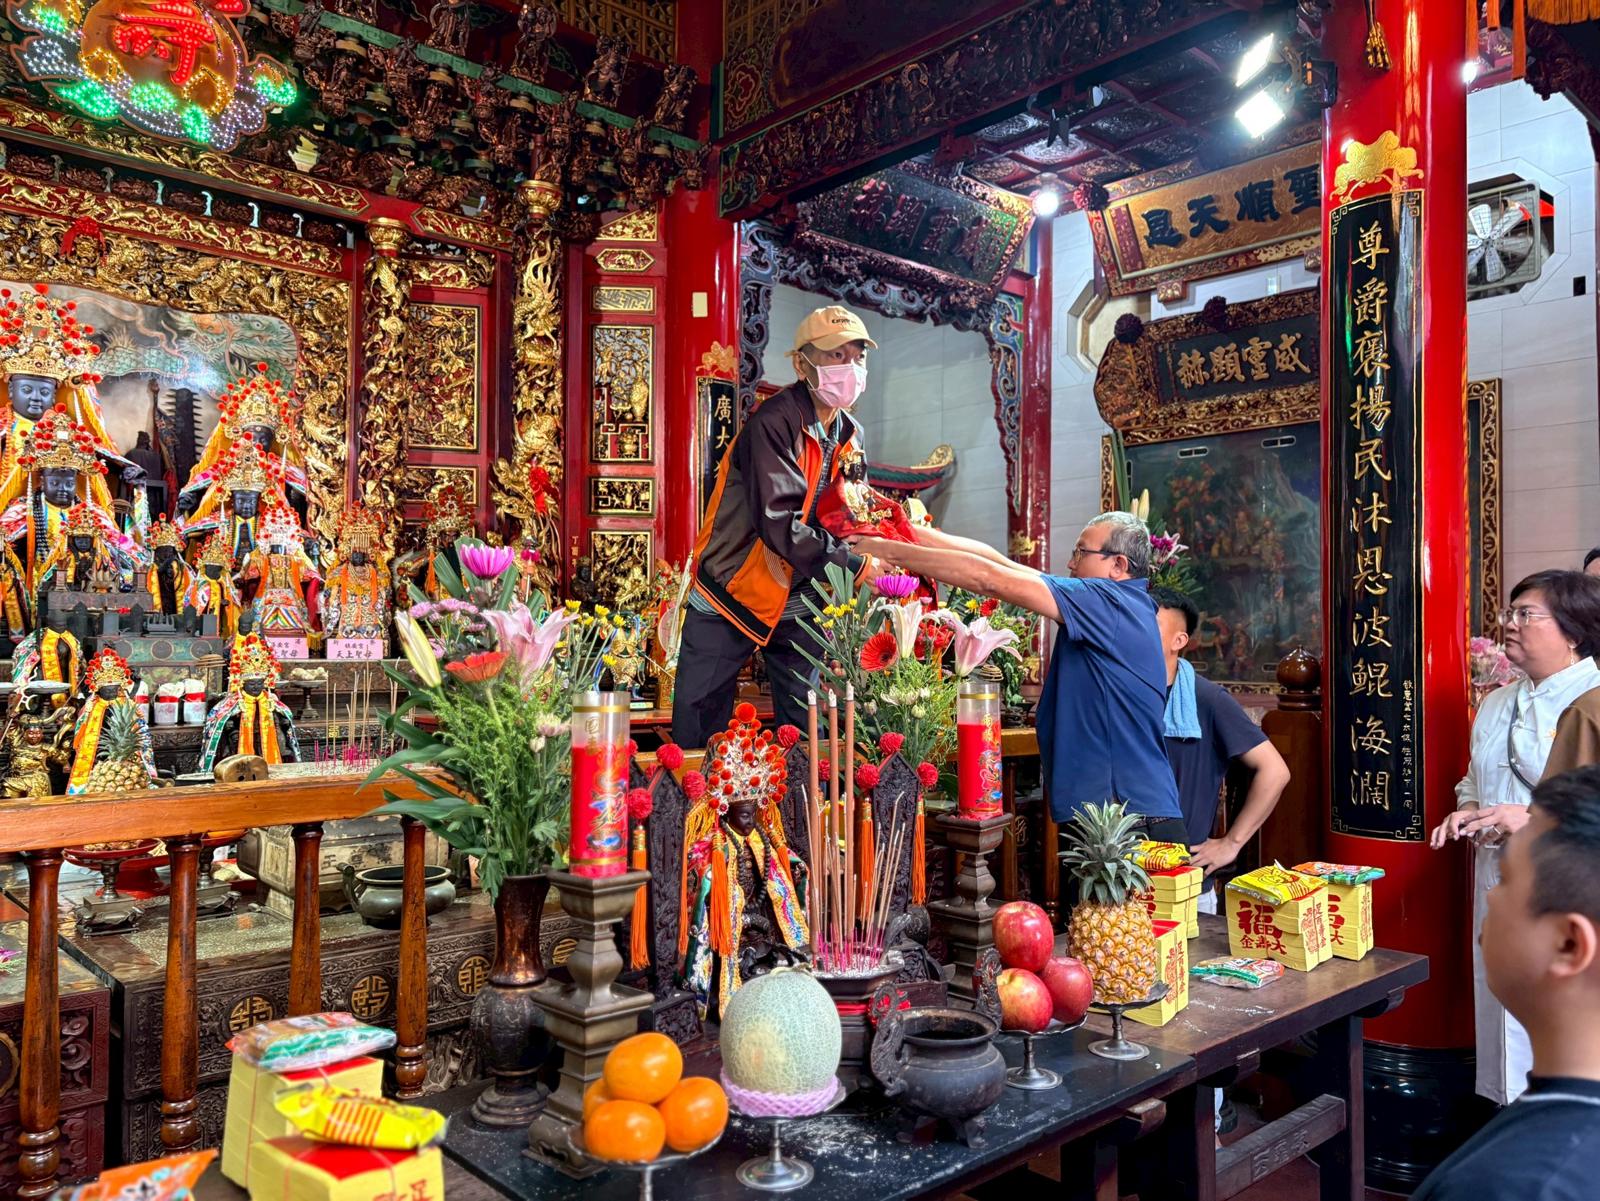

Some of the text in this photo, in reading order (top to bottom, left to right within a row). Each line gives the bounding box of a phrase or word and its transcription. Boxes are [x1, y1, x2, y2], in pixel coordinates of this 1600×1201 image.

[1175, 332, 1312, 390] 威靈顯赫
[714, 394, 732, 479] 廣大
[1236, 900, 1283, 938] 福
